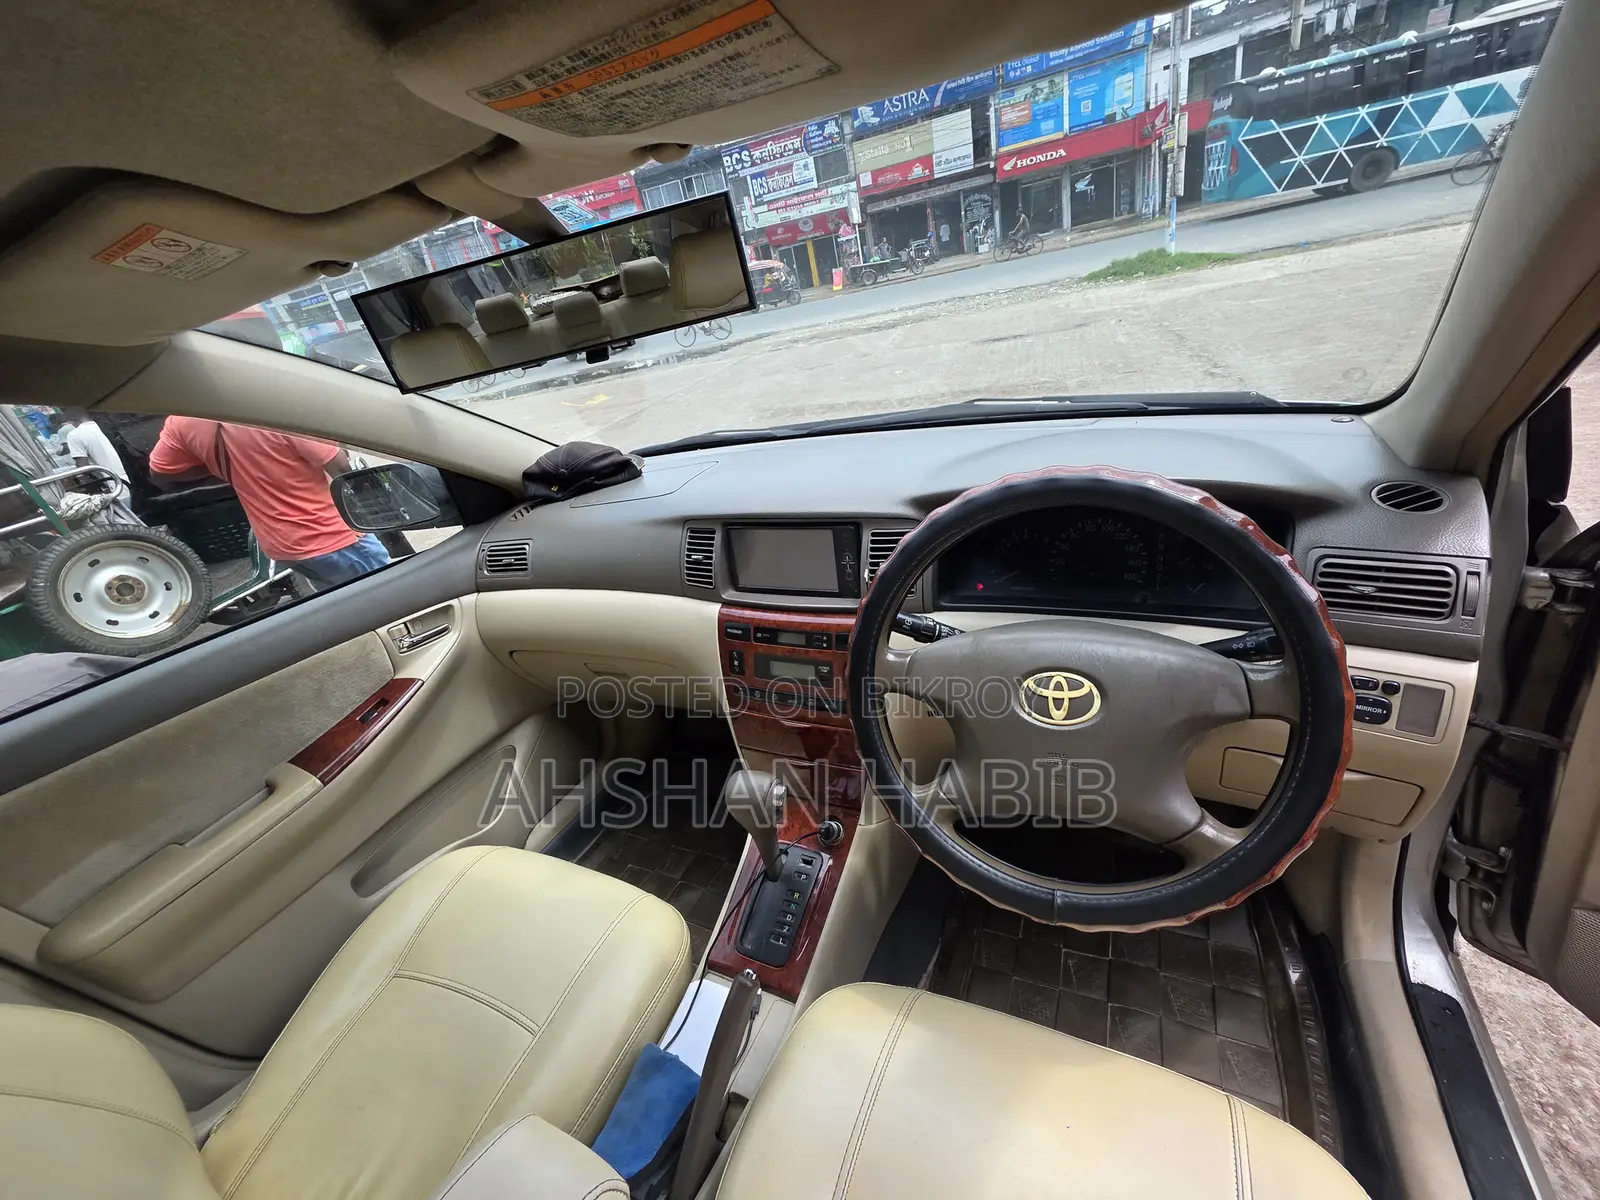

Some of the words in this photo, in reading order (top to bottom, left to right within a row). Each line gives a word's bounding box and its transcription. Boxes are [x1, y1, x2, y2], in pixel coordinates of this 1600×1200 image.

[1096, 30, 1124, 44] Solution
[883, 88, 930, 115] ASTRA
[723, 150, 751, 174] BCS
[864, 145, 890, 160] Stella
[1016, 148, 1067, 169] HONDA
[752, 177, 768, 197] BCS
[1355, 704, 1383, 714] MIRROR
